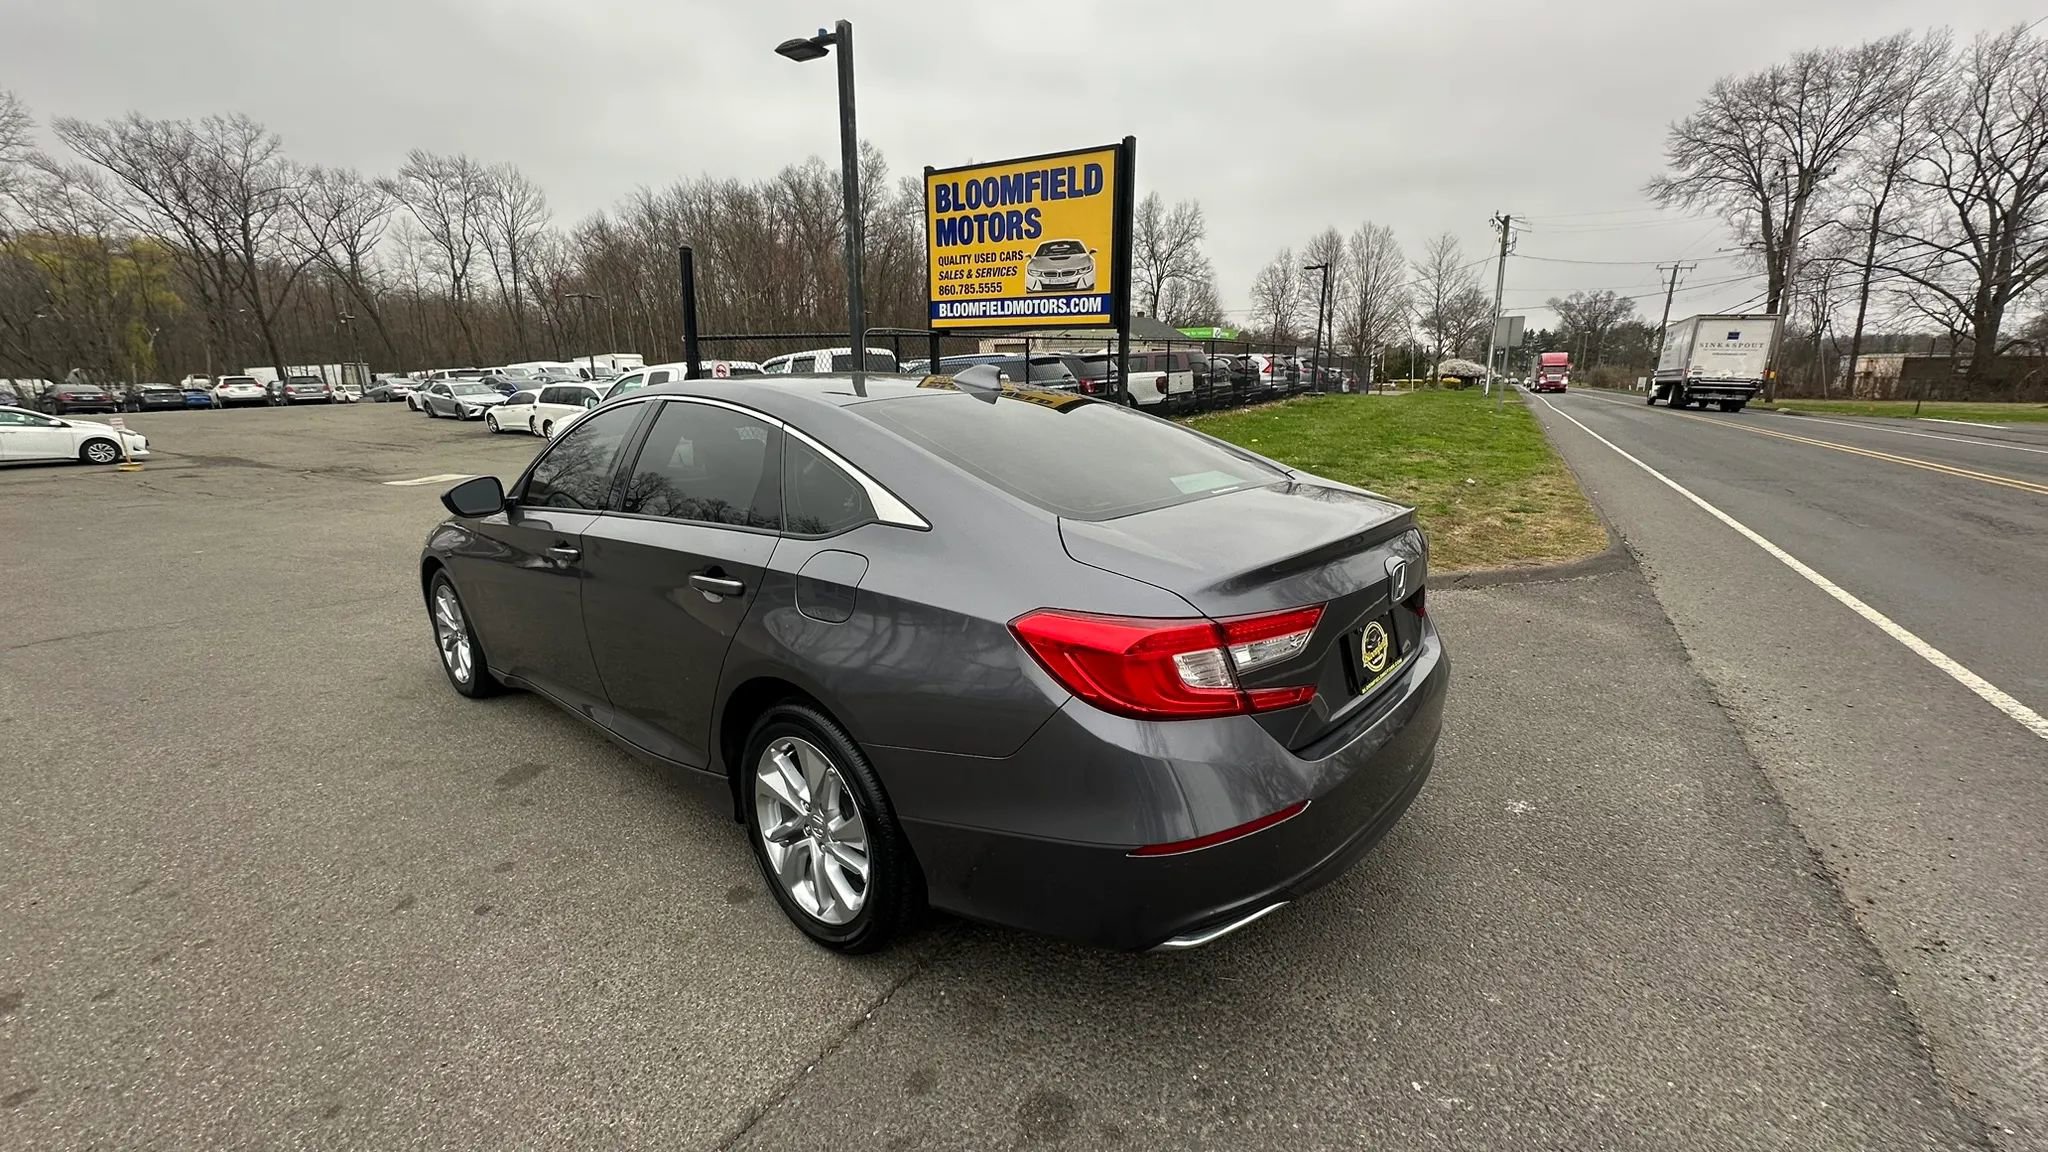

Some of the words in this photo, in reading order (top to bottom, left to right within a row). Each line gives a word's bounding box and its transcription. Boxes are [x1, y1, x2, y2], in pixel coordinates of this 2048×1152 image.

[935, 163, 1103, 214] BLOOMFIELD
[935, 208, 1042, 247] MOTORS
[938, 254, 971, 266] QUALITY
[974, 253, 997, 264] USED
[999, 250, 1024, 262] CARS
[938, 268, 964, 281] SALES
[966, 268, 973, 279] &
[975, 266, 1018, 279] SERVICES
[938, 282, 1002, 296] 860.785.5555
[939, 297, 1102, 317] BLOOMFIELDMOTORS.COM
